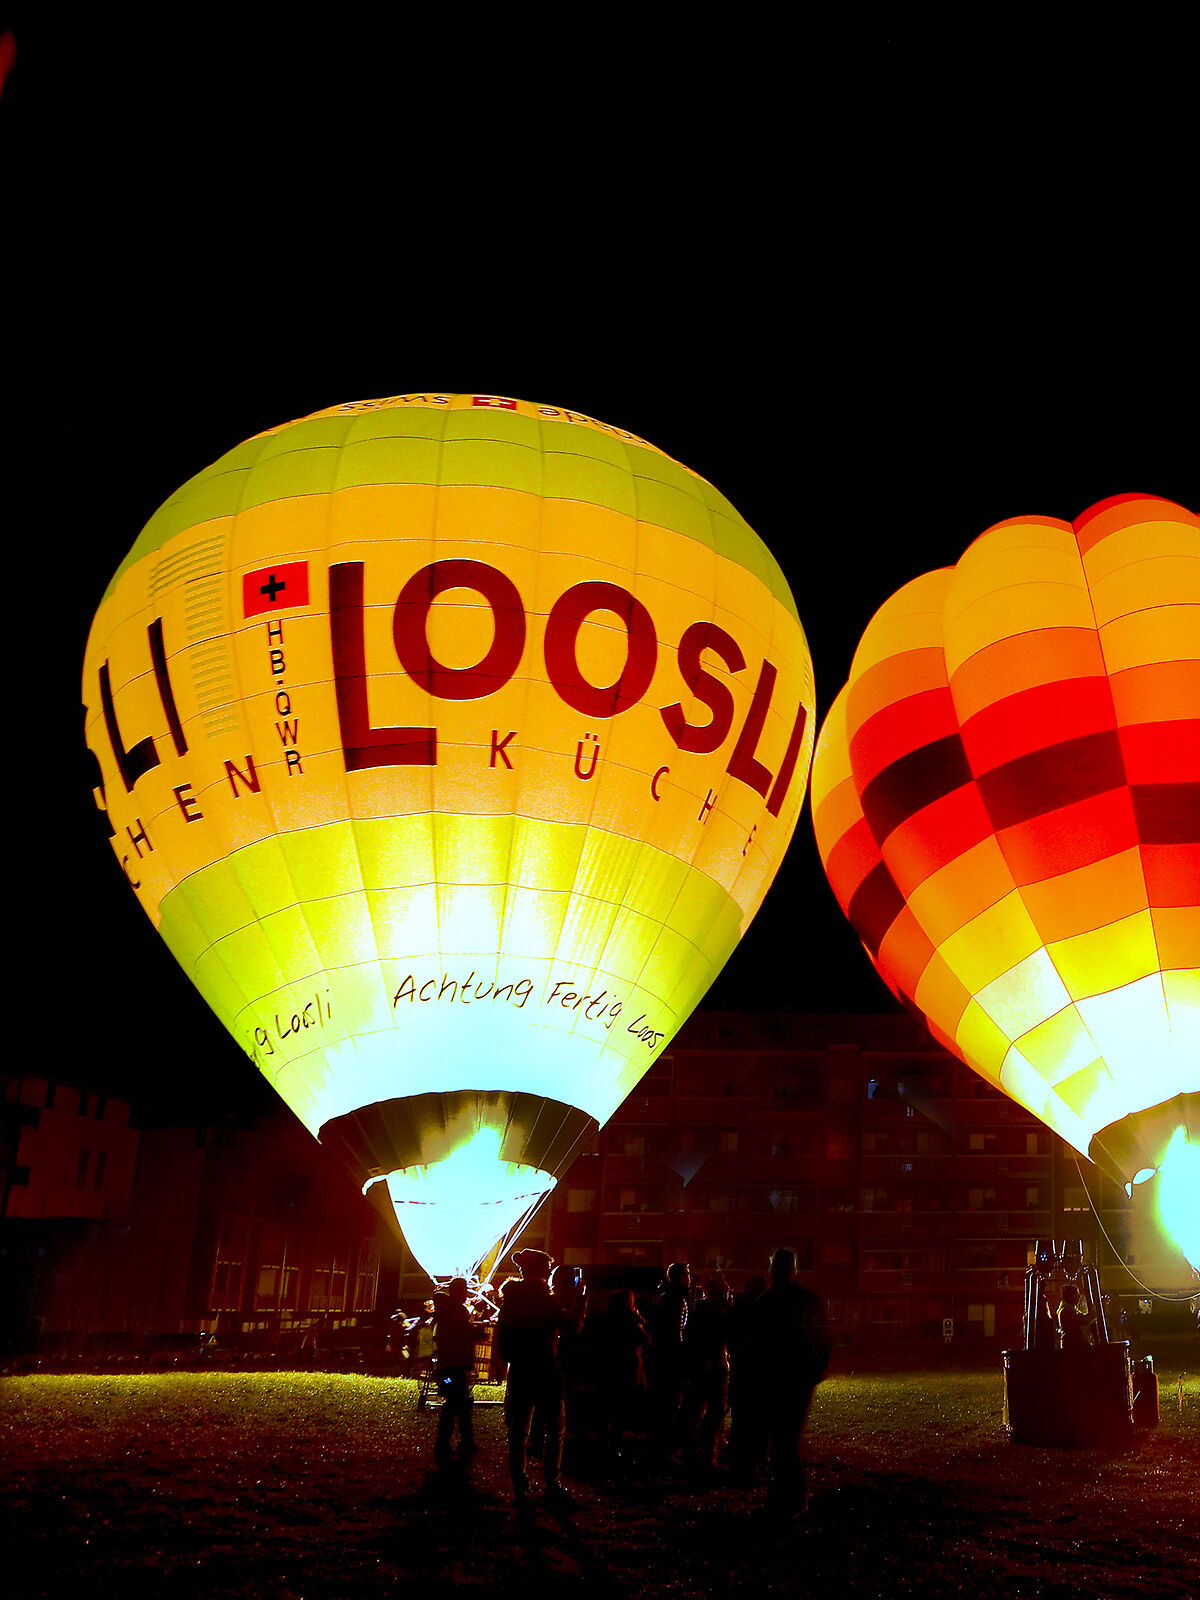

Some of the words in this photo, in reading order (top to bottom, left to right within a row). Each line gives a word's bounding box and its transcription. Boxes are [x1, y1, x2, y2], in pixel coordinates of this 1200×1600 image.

[329, 558, 808, 818] LOOSLI
[393, 971, 534, 1009] Achtung
[546, 981, 623, 1030] Fertig
